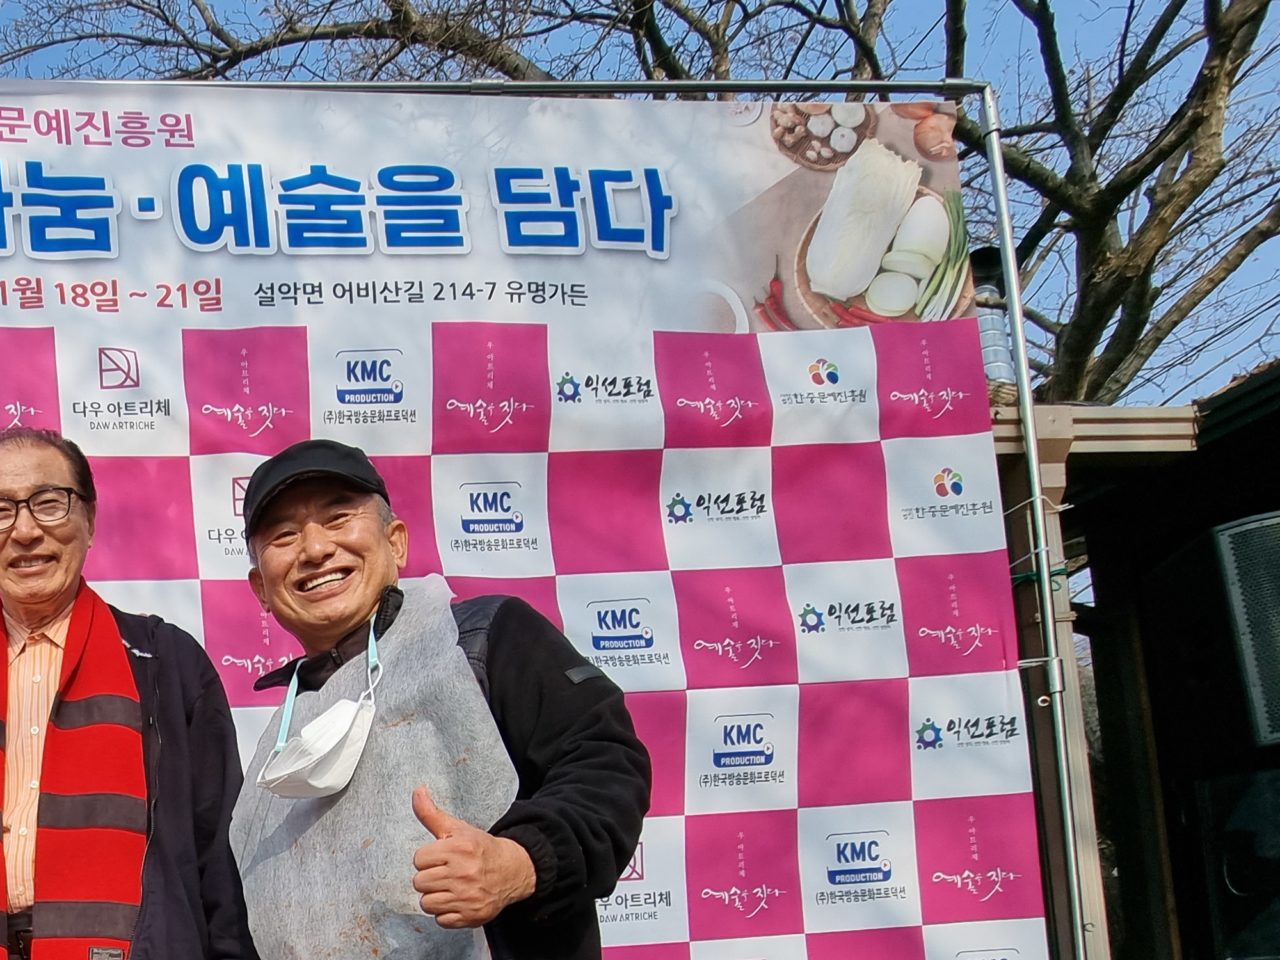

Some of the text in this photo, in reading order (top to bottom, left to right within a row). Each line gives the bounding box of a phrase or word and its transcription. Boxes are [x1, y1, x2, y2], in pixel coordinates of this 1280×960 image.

[493, 166, 674, 254] 담다
[253, 281, 324, 307] 설악면
[332, 281, 425, 306] 어비산길
[433, 282, 497, 302] 214-7
[504, 281, 589, 307] 유명가든
[346, 361, 391, 382] KMC
[584, 376, 654, 398] 익선포럼
[345, 394, 394, 402] PRODUCTION
[323, 410, 416, 424] (주)한국방송문화프로덕션
[470, 492, 511, 512] KMC
[696, 491, 767, 514] 익선포럼
[469, 524, 515, 532] PRODUCTION
[451, 539, 538, 551] (주)한국방송문화프로덕션
[597, 608, 640, 629] KMC
[828, 600, 897, 624] 익선포럼
[723, 724, 764, 746] KMC
[946, 716, 1020, 738] 익선포럼
[721, 755, 765, 765] PRODUCTION
[699, 770, 785, 787] (주)한국방송문화프로덕션
[837, 840, 880, 863] KMC
[835, 873, 883, 882] PRODUCTION
[816, 886, 906, 905] (주)한국방송문화프로덕션
